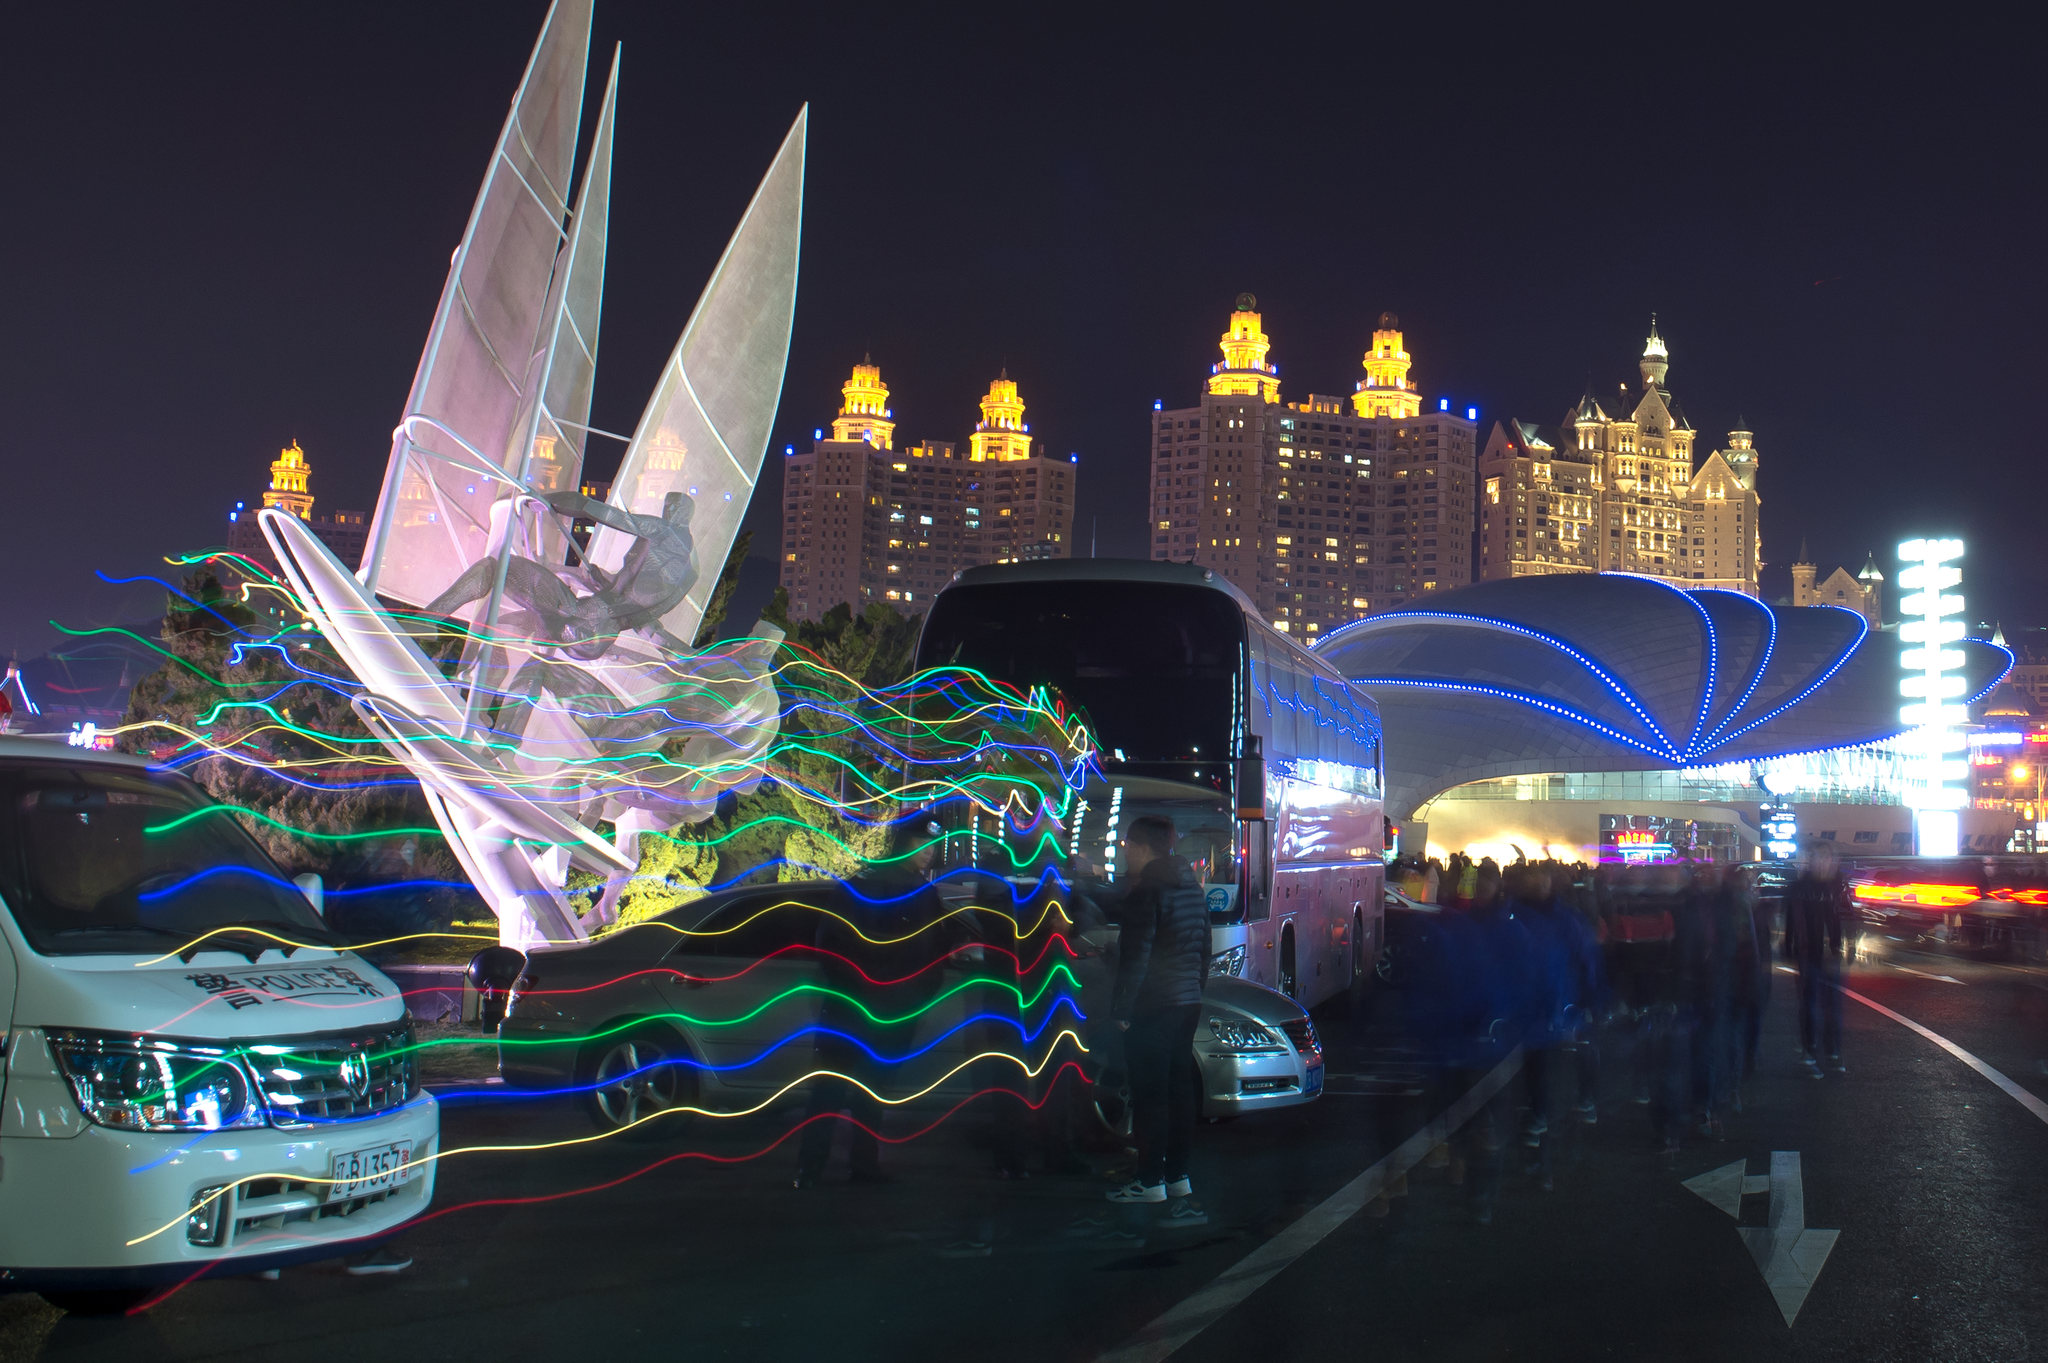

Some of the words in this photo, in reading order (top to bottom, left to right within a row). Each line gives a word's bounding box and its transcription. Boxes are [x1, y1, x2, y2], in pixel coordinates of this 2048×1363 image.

[185, 973, 263, 1010] 警
[244, 973, 347, 993] POLICE
[321, 966, 385, 998] 察
